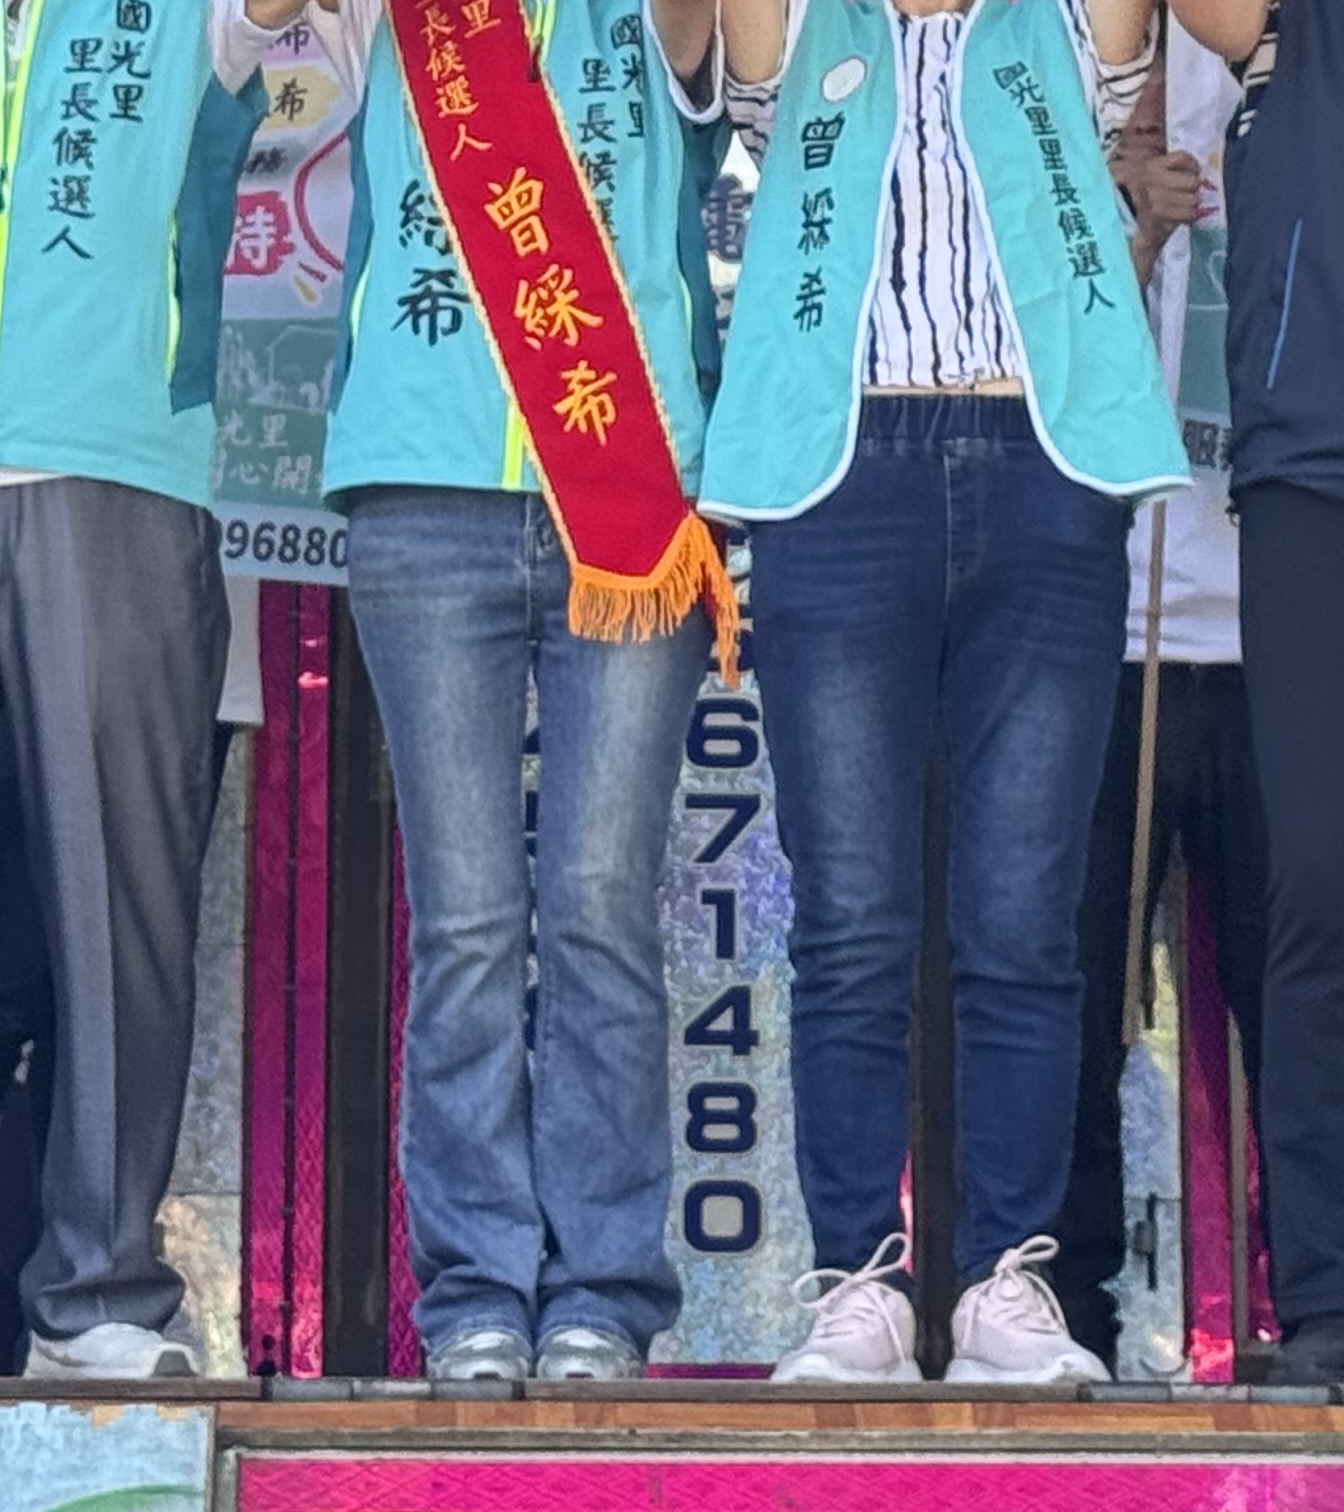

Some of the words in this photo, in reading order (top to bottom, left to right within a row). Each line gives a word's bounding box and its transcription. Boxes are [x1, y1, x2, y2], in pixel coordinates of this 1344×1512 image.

[41, 37, 105, 262] 里長候選人
[791, 110, 845, 334] 曾綵希
[993, 61, 1116, 315] 國光里里長候選人
[484, 167, 617, 447] 曾綵希
[219, 517, 349, 568] 96880
